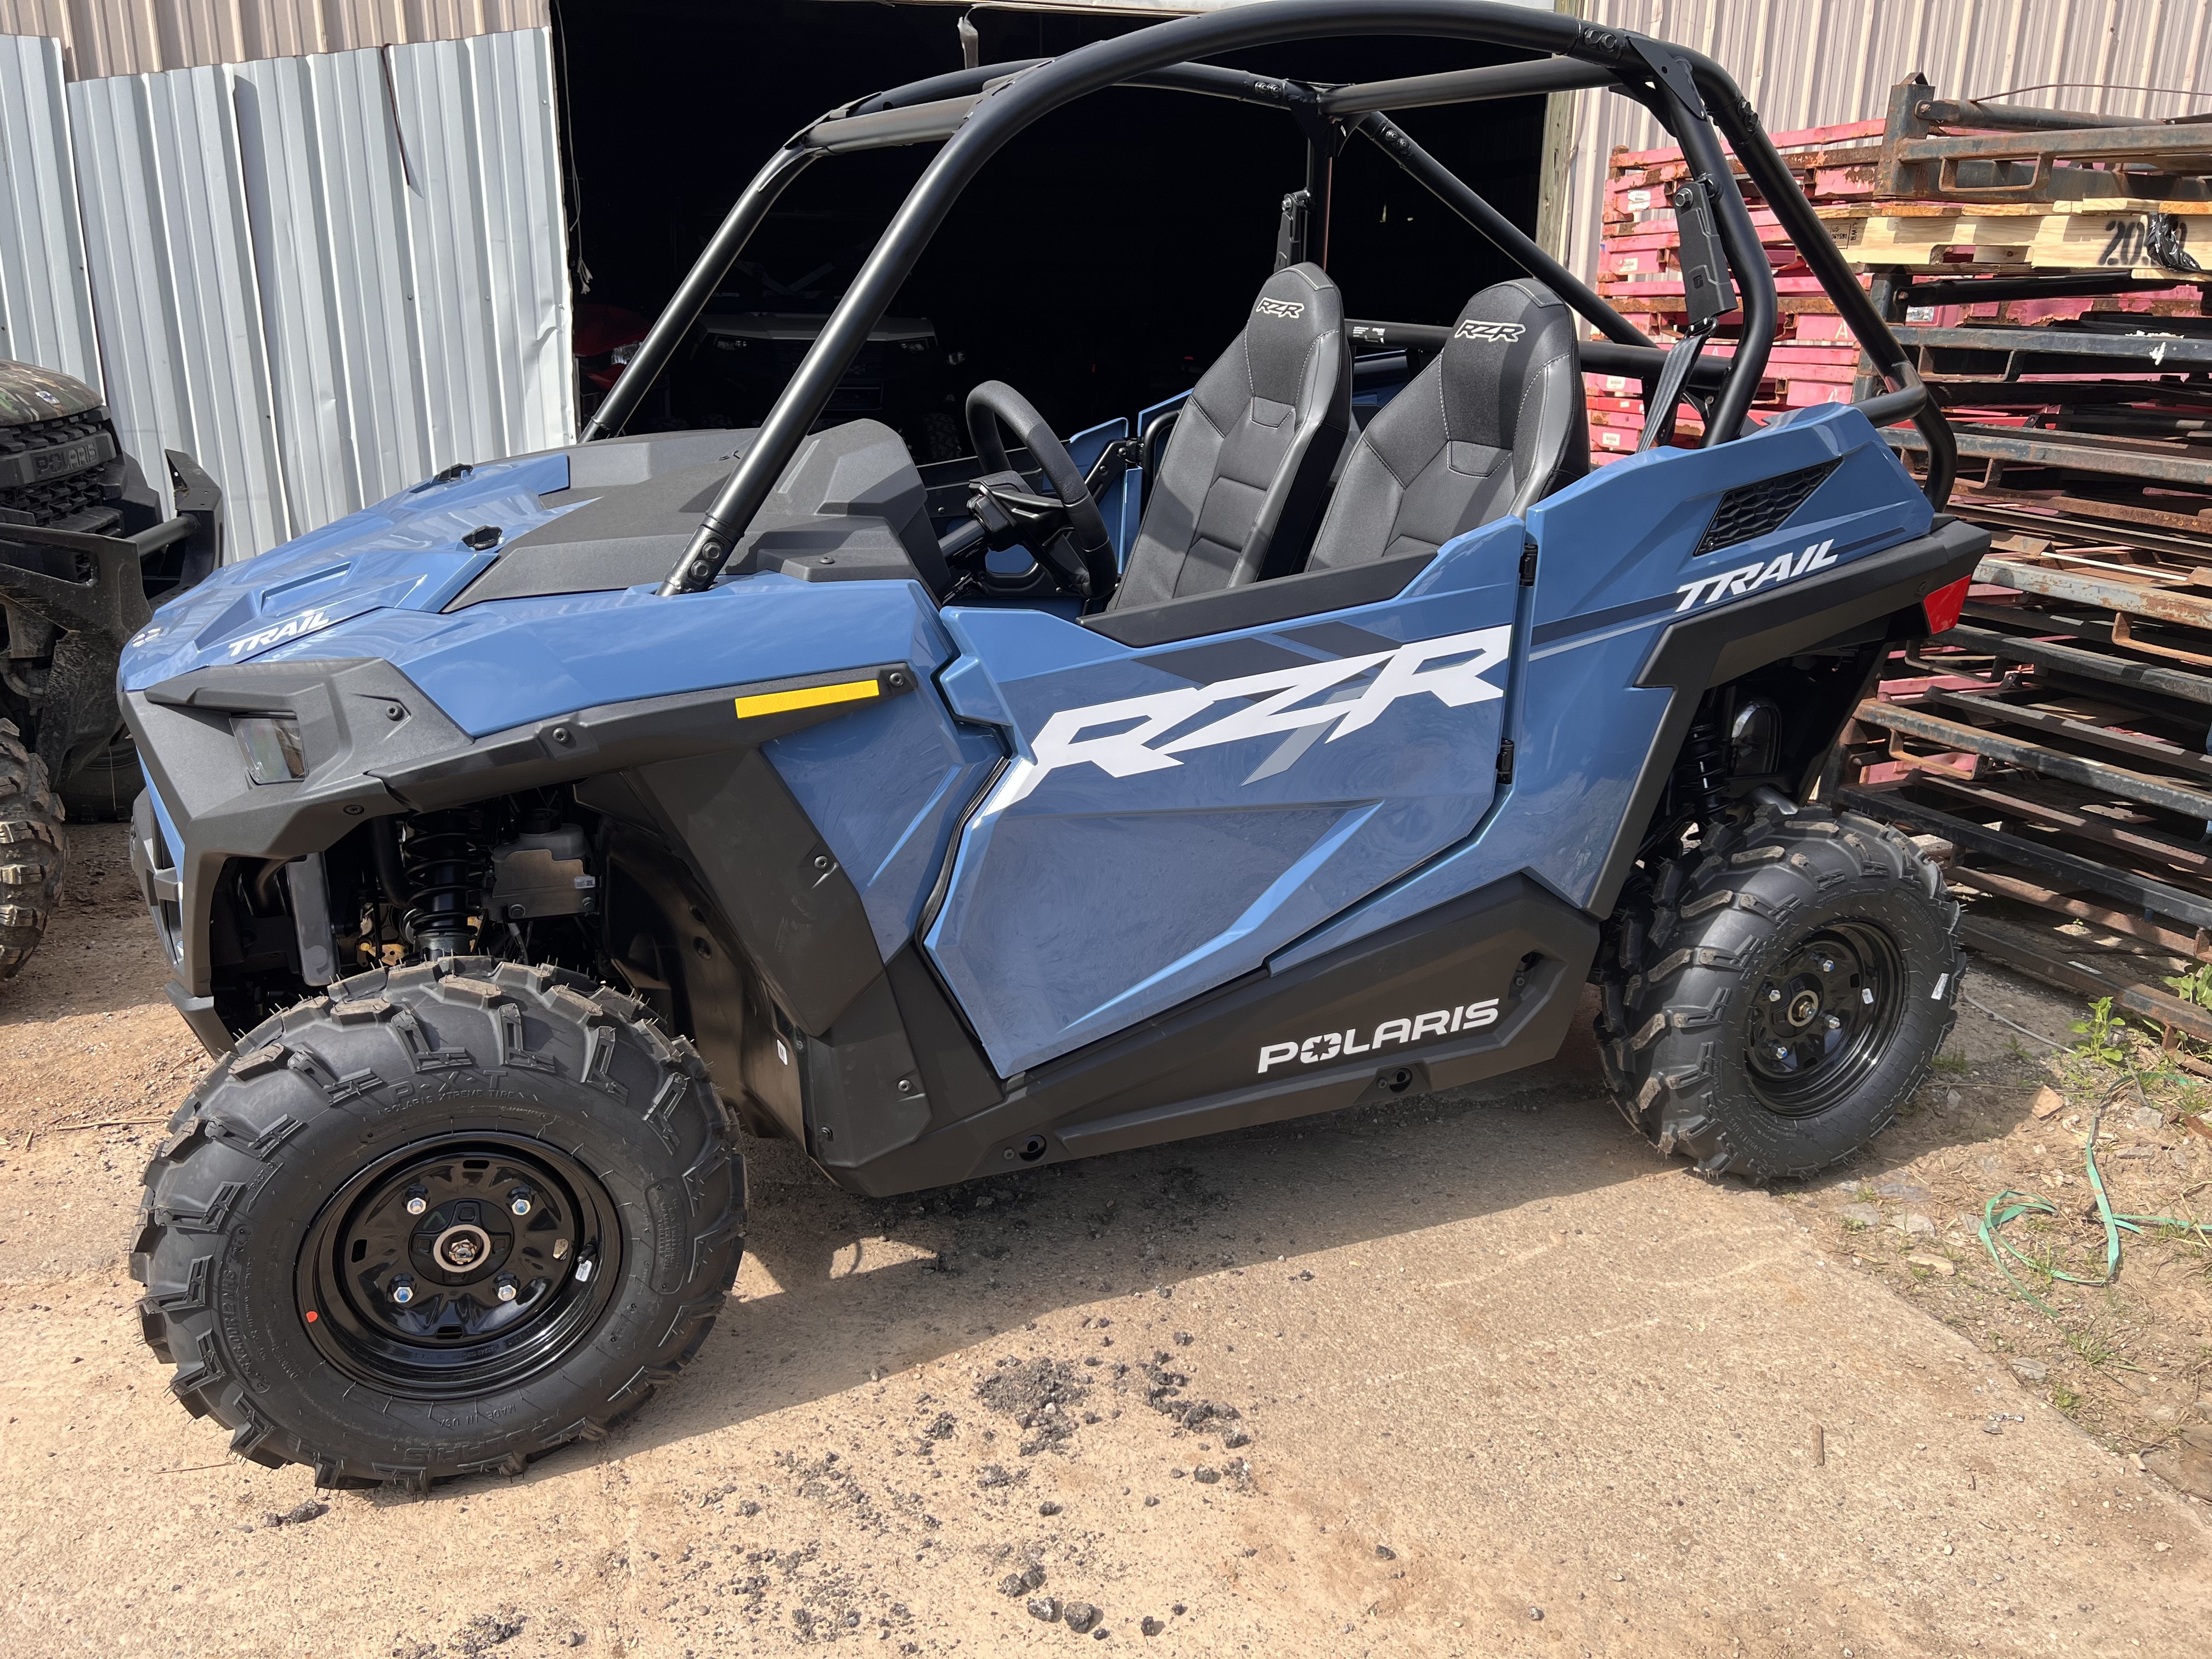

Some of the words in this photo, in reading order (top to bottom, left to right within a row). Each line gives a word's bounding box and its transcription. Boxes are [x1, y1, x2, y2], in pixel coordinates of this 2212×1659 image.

[1256, 297, 1305, 319] RZR
[1454, 319, 1527, 343] RZR
[34, 443, 99, 478] POLARIS
[1675, 539, 1839, 613] TRAIL
[228, 610, 332, 658] TRAIL
[982, 624, 1512, 817] RZR
[1257, 997, 1500, 1074] POLARIS
[438, 1417, 460, 1427] USA
[466, 1414, 479, 1424] IN
[486, 1403, 517, 1420] MADE
